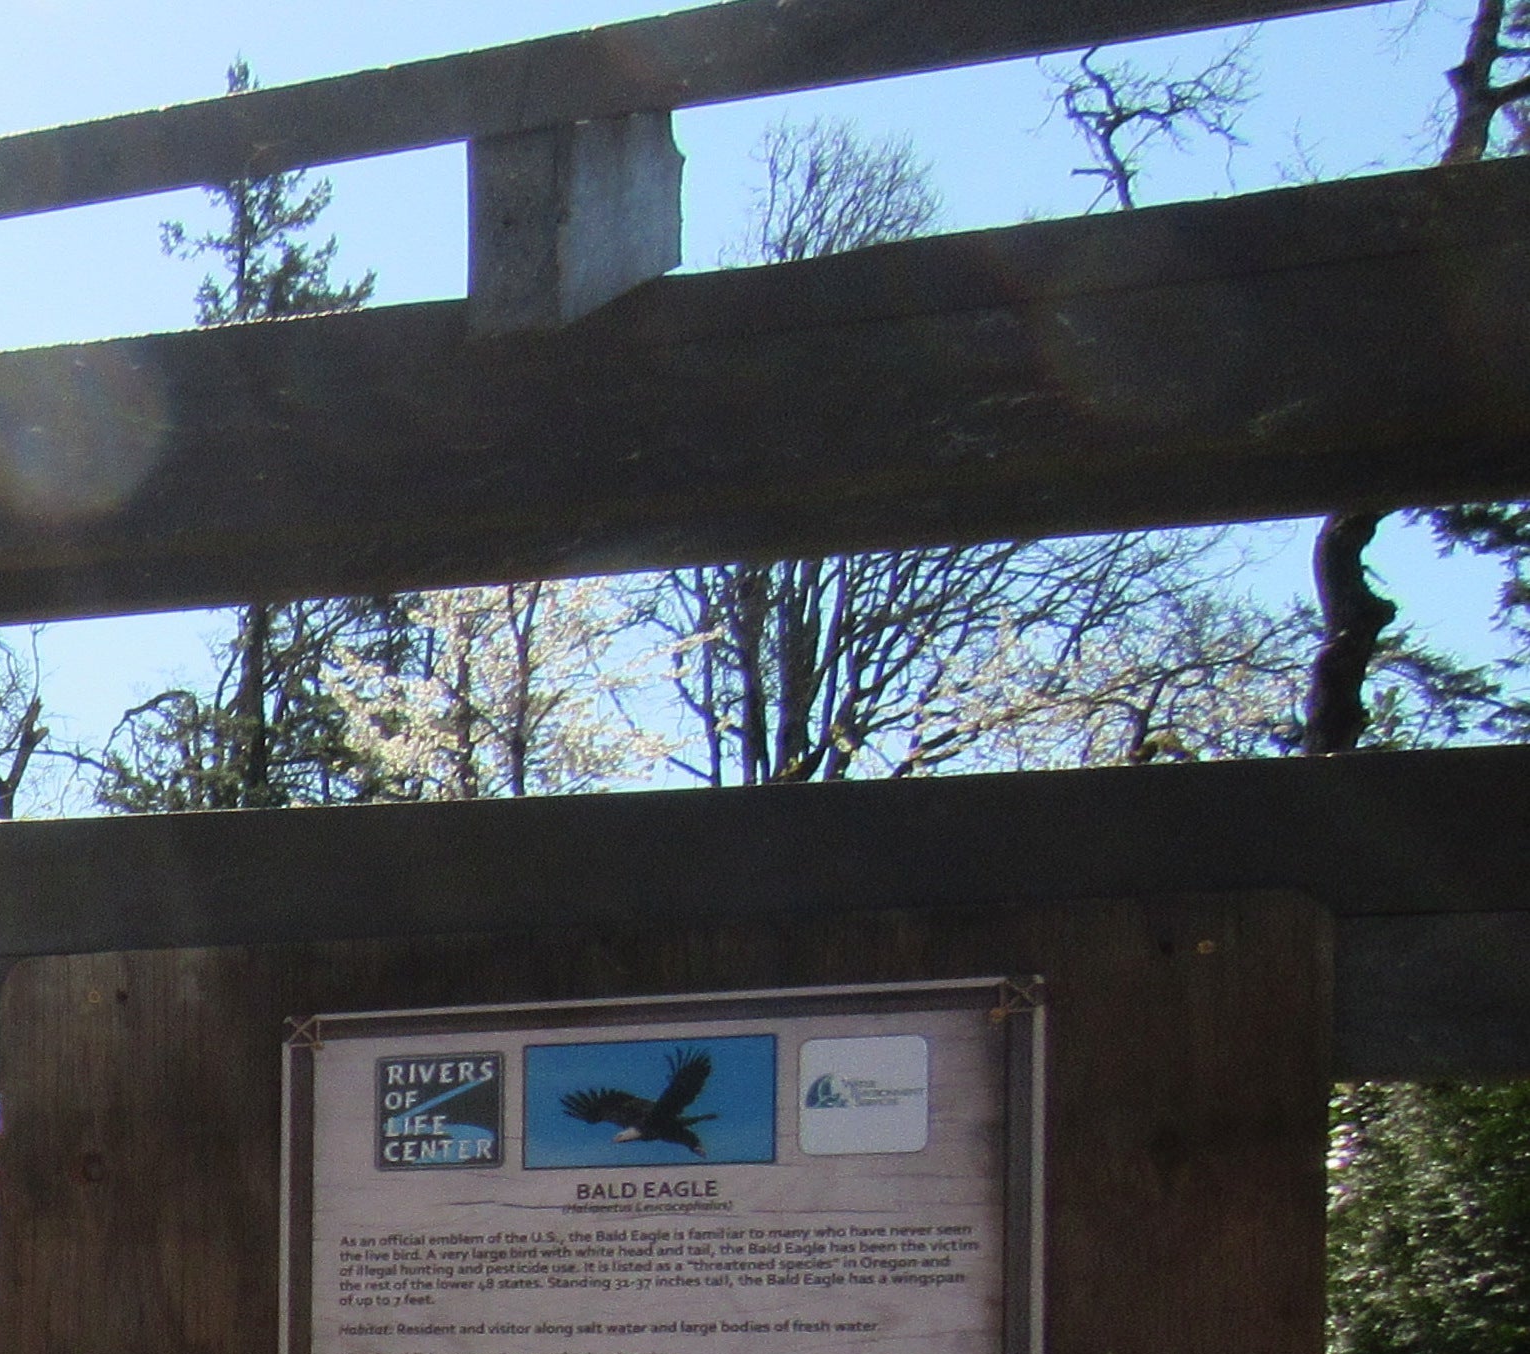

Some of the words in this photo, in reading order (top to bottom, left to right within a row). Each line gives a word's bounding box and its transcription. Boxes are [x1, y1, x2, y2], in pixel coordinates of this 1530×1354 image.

[387, 1062, 493, 1085] RIVERS
[385, 1091, 419, 1110] OF
[385, 1116, 447, 1136] LIFE
[384, 1139, 492, 1161] CENTER
[577, 1183, 637, 1199] BALD
[644, 1180, 718, 1198] EAGLE
[341, 1235, 357, 1247] As
[360, 1238, 376, 1246] an
[379, 1234, 425, 1246] official
[429, 1233, 484, 1245] emblem
[487, 1233, 502, 1244] of
[504, 1232, 528, 1244] the
[568, 1232, 592, 1243] the
[595, 1231, 627, 1242] Bald
[631, 1231, 670, 1245] Eagle
[673, 1230, 684, 1242] is
[688, 1229, 745, 1241] familiar
[749, 1230, 765, 1239] to
[769, 1230, 809, 1242] many
[815, 1227, 846, 1238] who
[850, 1226, 887, 1237] have
[890, 1228, 932, 1236] never
[937, 1227, 972, 1236] seen
[340, 1250, 362, 1262] the
[365, 1250, 390, 1261] live
[426, 1249, 437, 1260] A
[441, 1252, 468, 1263] very
[472, 1248, 506, 1263] large
[509, 1248, 537, 1259] bird
[540, 1247, 571, 1258] with
[576, 1246, 614, 1258] white
[618, 1245, 652, 1257] head
[656, 1245, 683, 1256] and
[720, 1244, 742, 1255] the
[748, 1243, 781, 1254] Bald
[785, 1242, 825, 1257] Eagle
[830, 1242, 855, 1253] has
[859, 1241, 898, 1252] been
[901, 1240, 927, 1251] the
[929, 1239, 980, 1251] victim
[340, 1265, 354, 1277] of
[356, 1265, 397, 1279] illegal
[400, 1264, 454, 1278] hunting
[458, 1263, 483, 1275] and
[486, 1262, 548, 1277] pesticide
[584, 1261, 595, 1273] It
[598, 1261, 608, 1272] is
[612, 1261, 652, 1272] listed
[656, 1263, 671, 1272] as
[675, 1263, 683, 1271] a
[843, 1258, 857, 1269] in
[860, 1257, 917, 1272] Oregon
[921, 1257, 951, 1268] and
[340, 1279, 362, 1291] the
[365, 1281, 391, 1290] rest
[393, 1279, 408, 1290] of
[411, 1279, 433, 1290] the
[436, 1278, 474, 1290] lower
[547, 1277, 611, 1291] Standing
[655, 1275, 701, 1286] inches
[738, 1274, 763, 1285] the
[767, 1273, 800, 1285] Bald
[803, 1273, 845, 1287] Eagle
[849, 1273, 875, 1284] has
[878, 1275, 887, 1284] a
[891, 1272, 966, 1286] wingspan
[339, 1294, 354, 1306] of
[355, 1297, 373, 1309] up
[376, 1296, 390, 1305] to
[397, 1323, 455, 1335] Resident
[459, 1323, 484, 1334] and
[488, 1323, 530, 1334] visitor
[534, 1323, 573, 1337] along
[576, 1322, 603, 1334] salt
[607, 1324, 647, 1333] water
[650, 1322, 677, 1333] and
[680, 1321, 717, 1336] large
[721, 1321, 771, 1332] bodies
[773, 1320, 789, 1332] of
[793, 1320, 831, 1331] fresh
